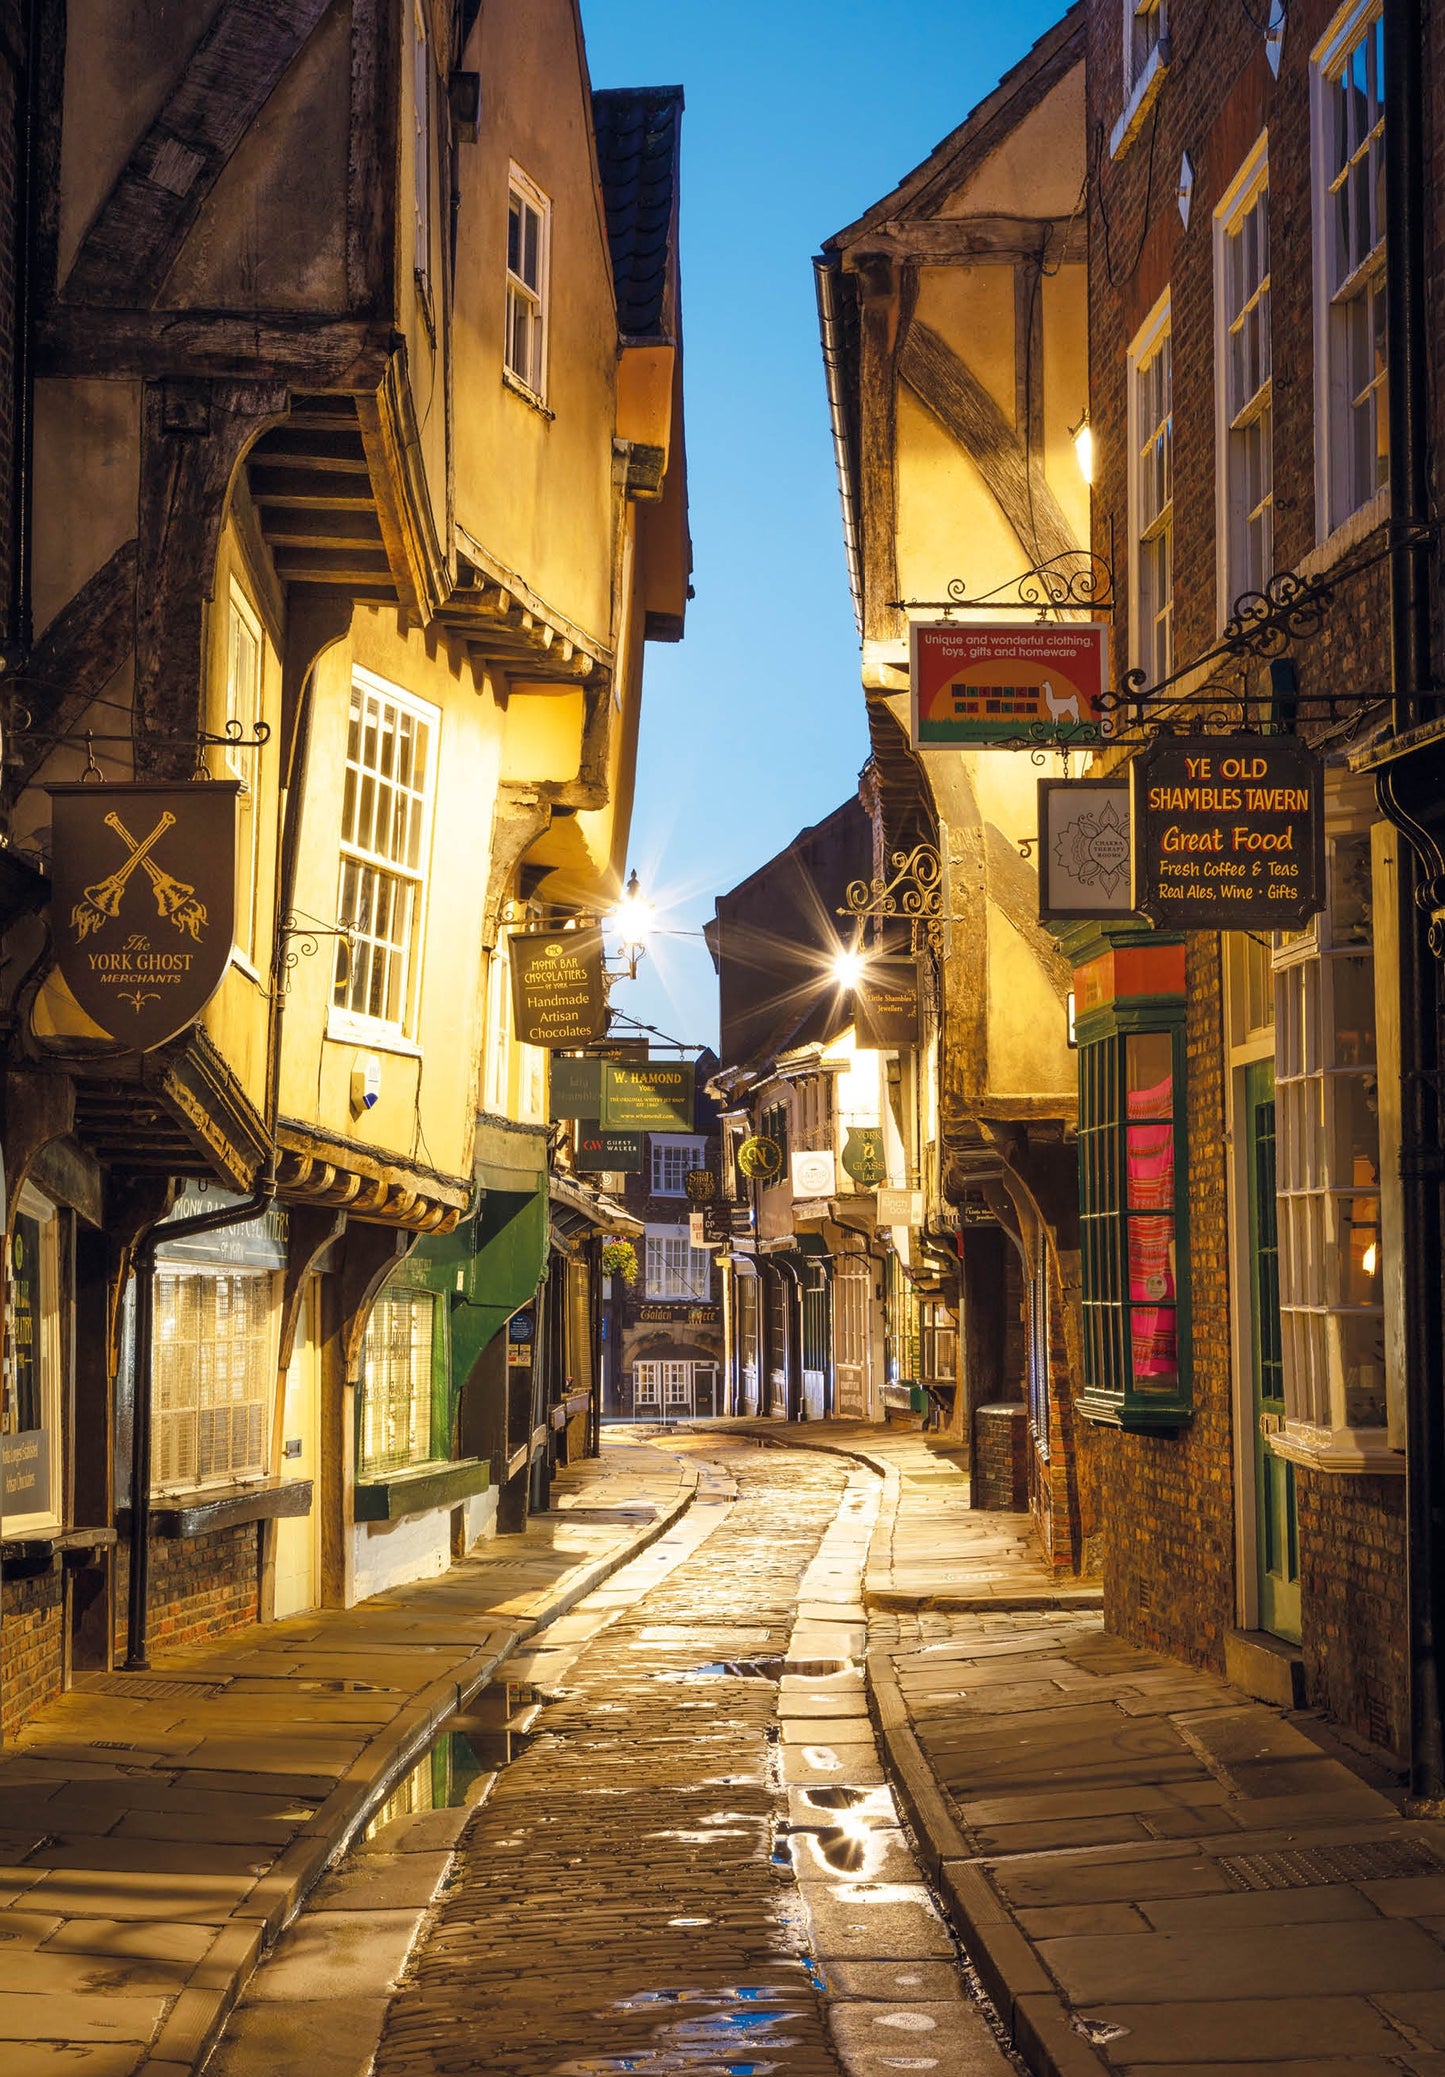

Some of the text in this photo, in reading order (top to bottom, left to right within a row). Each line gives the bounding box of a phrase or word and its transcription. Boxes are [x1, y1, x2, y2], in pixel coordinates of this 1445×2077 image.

[924, 634, 1094, 647] Unique and wonderful clothing,
[942, 647, 1077, 658] toys, gifts and homeware
[1184, 758, 1268, 780] YE OLD
[1148, 788, 1309, 813] SHAMBLES TAVERN
[1161, 825, 1293, 853] Great Food
[1159, 860, 1299, 877] Fresh Coffee & Teas
[1158, 883, 1298, 900] Real Ales, Wine Gifts
[122, 934, 152, 951] The
[88, 954, 194, 970] YORK GHOST
[532, 958, 578, 971] MONK BAR
[100, 974, 181, 984] MERCHANTS
[524, 968, 588, 984] CHOCOLATIERS
[528, 992, 590, 1008] Handmade
[884, 994, 912, 1002] Shambles
[877, 1004, 903, 1014] Jewellers
[540, 1010, 579, 1023] Artisan
[530, 1026, 592, 1040] Chocolates
[614, 1072, 682, 1084] W. HAMOND
[620, 1112, 674, 1120] www.whamond.com
[856, 1130, 882, 1140] YORK
[852, 1162, 885, 1171] GLASS
[174, 1197, 203, 1220] MONK
[640, 1310, 672, 1320] Golden
